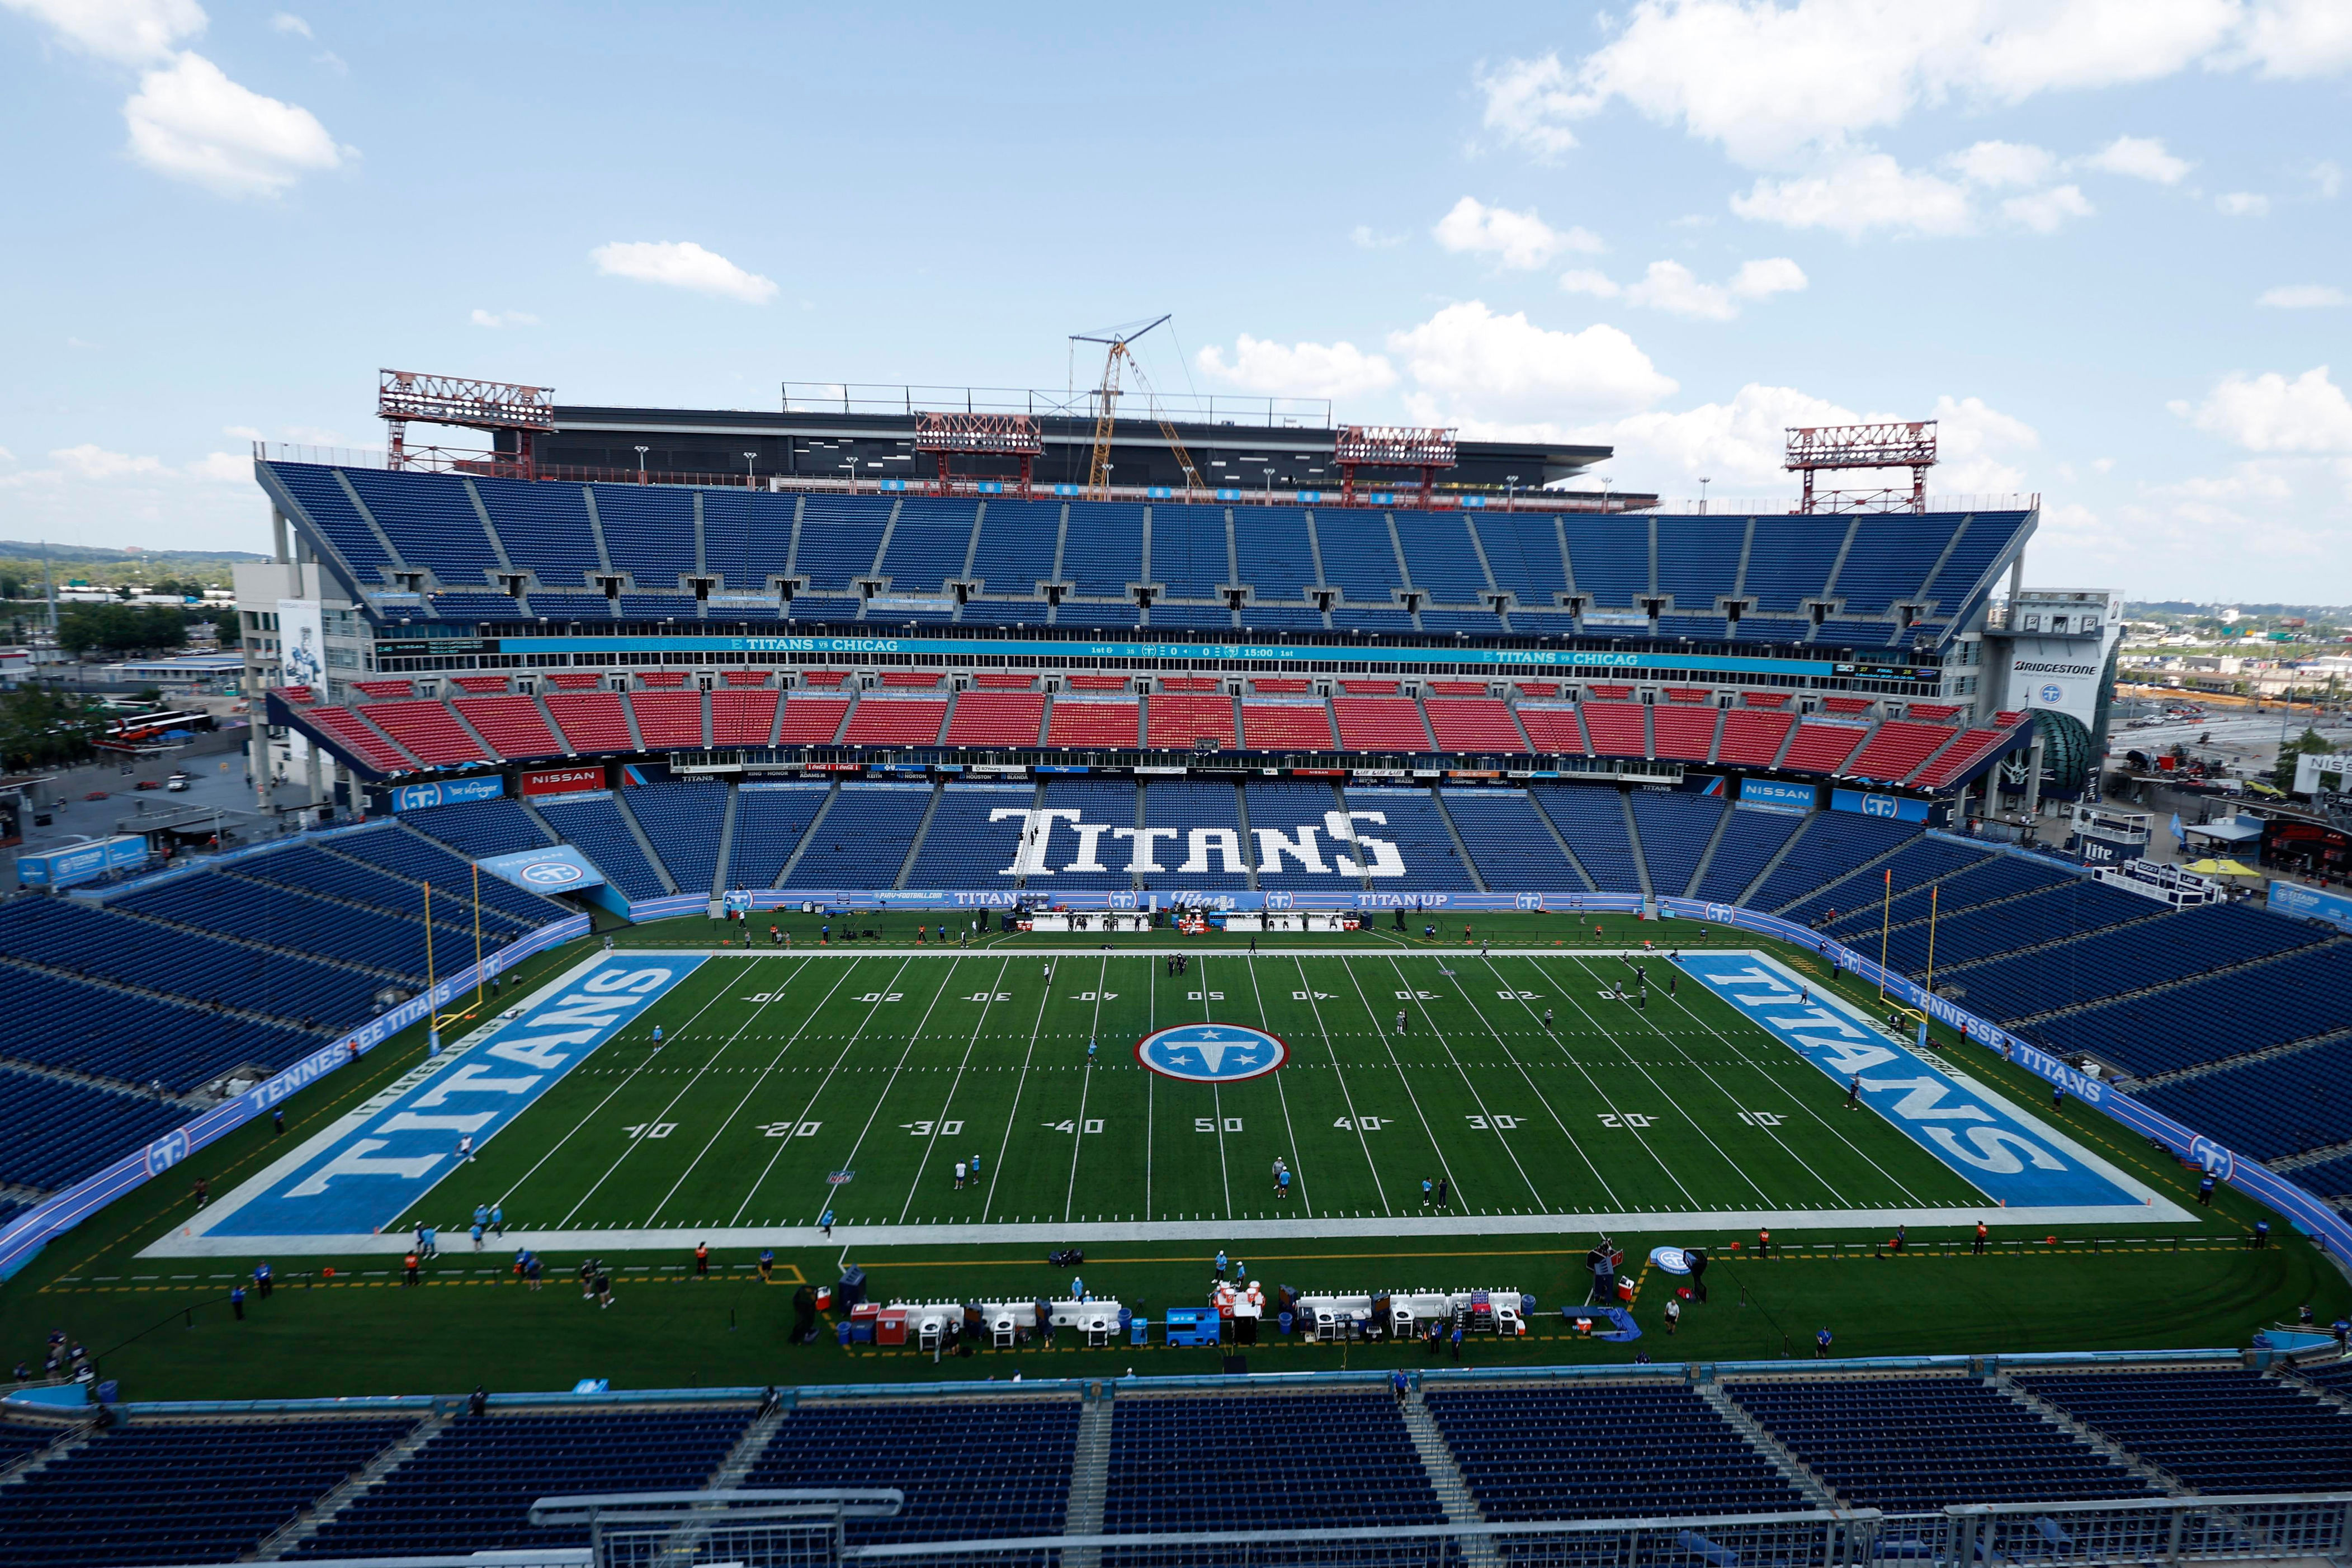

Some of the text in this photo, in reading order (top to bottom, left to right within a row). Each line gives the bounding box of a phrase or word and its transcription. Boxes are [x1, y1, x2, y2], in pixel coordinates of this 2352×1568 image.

[746, 639, 814, 650] TITANS
[1202, 648, 1210, 656] 0
[1496, 652, 1556, 663] TITANS
[2013, 661, 2098, 676] BRIDGESTONE
[532, 772, 594, 783] NISSAN
[464, 781, 498, 797] Kroger
[1745, 785, 1810, 800] NISSAN
[989, 808, 1407, 876] TITANS
[2085, 842, 2113, 861] Lite
[955, 893, 1017, 905] TITAN
[1171, 891, 1235, 909] Titans
[1358, 894, 1447, 906] TITAN UP
[387, 984, 450, 1031] TITANS
[1910, 986, 2100, 1102] TENNESSEE TITANS
[351, 1103, 383, 1116] IT
[379, 1061, 446, 1098] TAKES
[444, 1037, 482, 1056] ALL
[476, 1022, 502, 1035] OF
[1704, 967, 2068, 1174] TITANS
[282, 967, 673, 1198] TITANS
[628, 1112, 1783, 1138] 10 20 30 40 50 40 30 20 10
